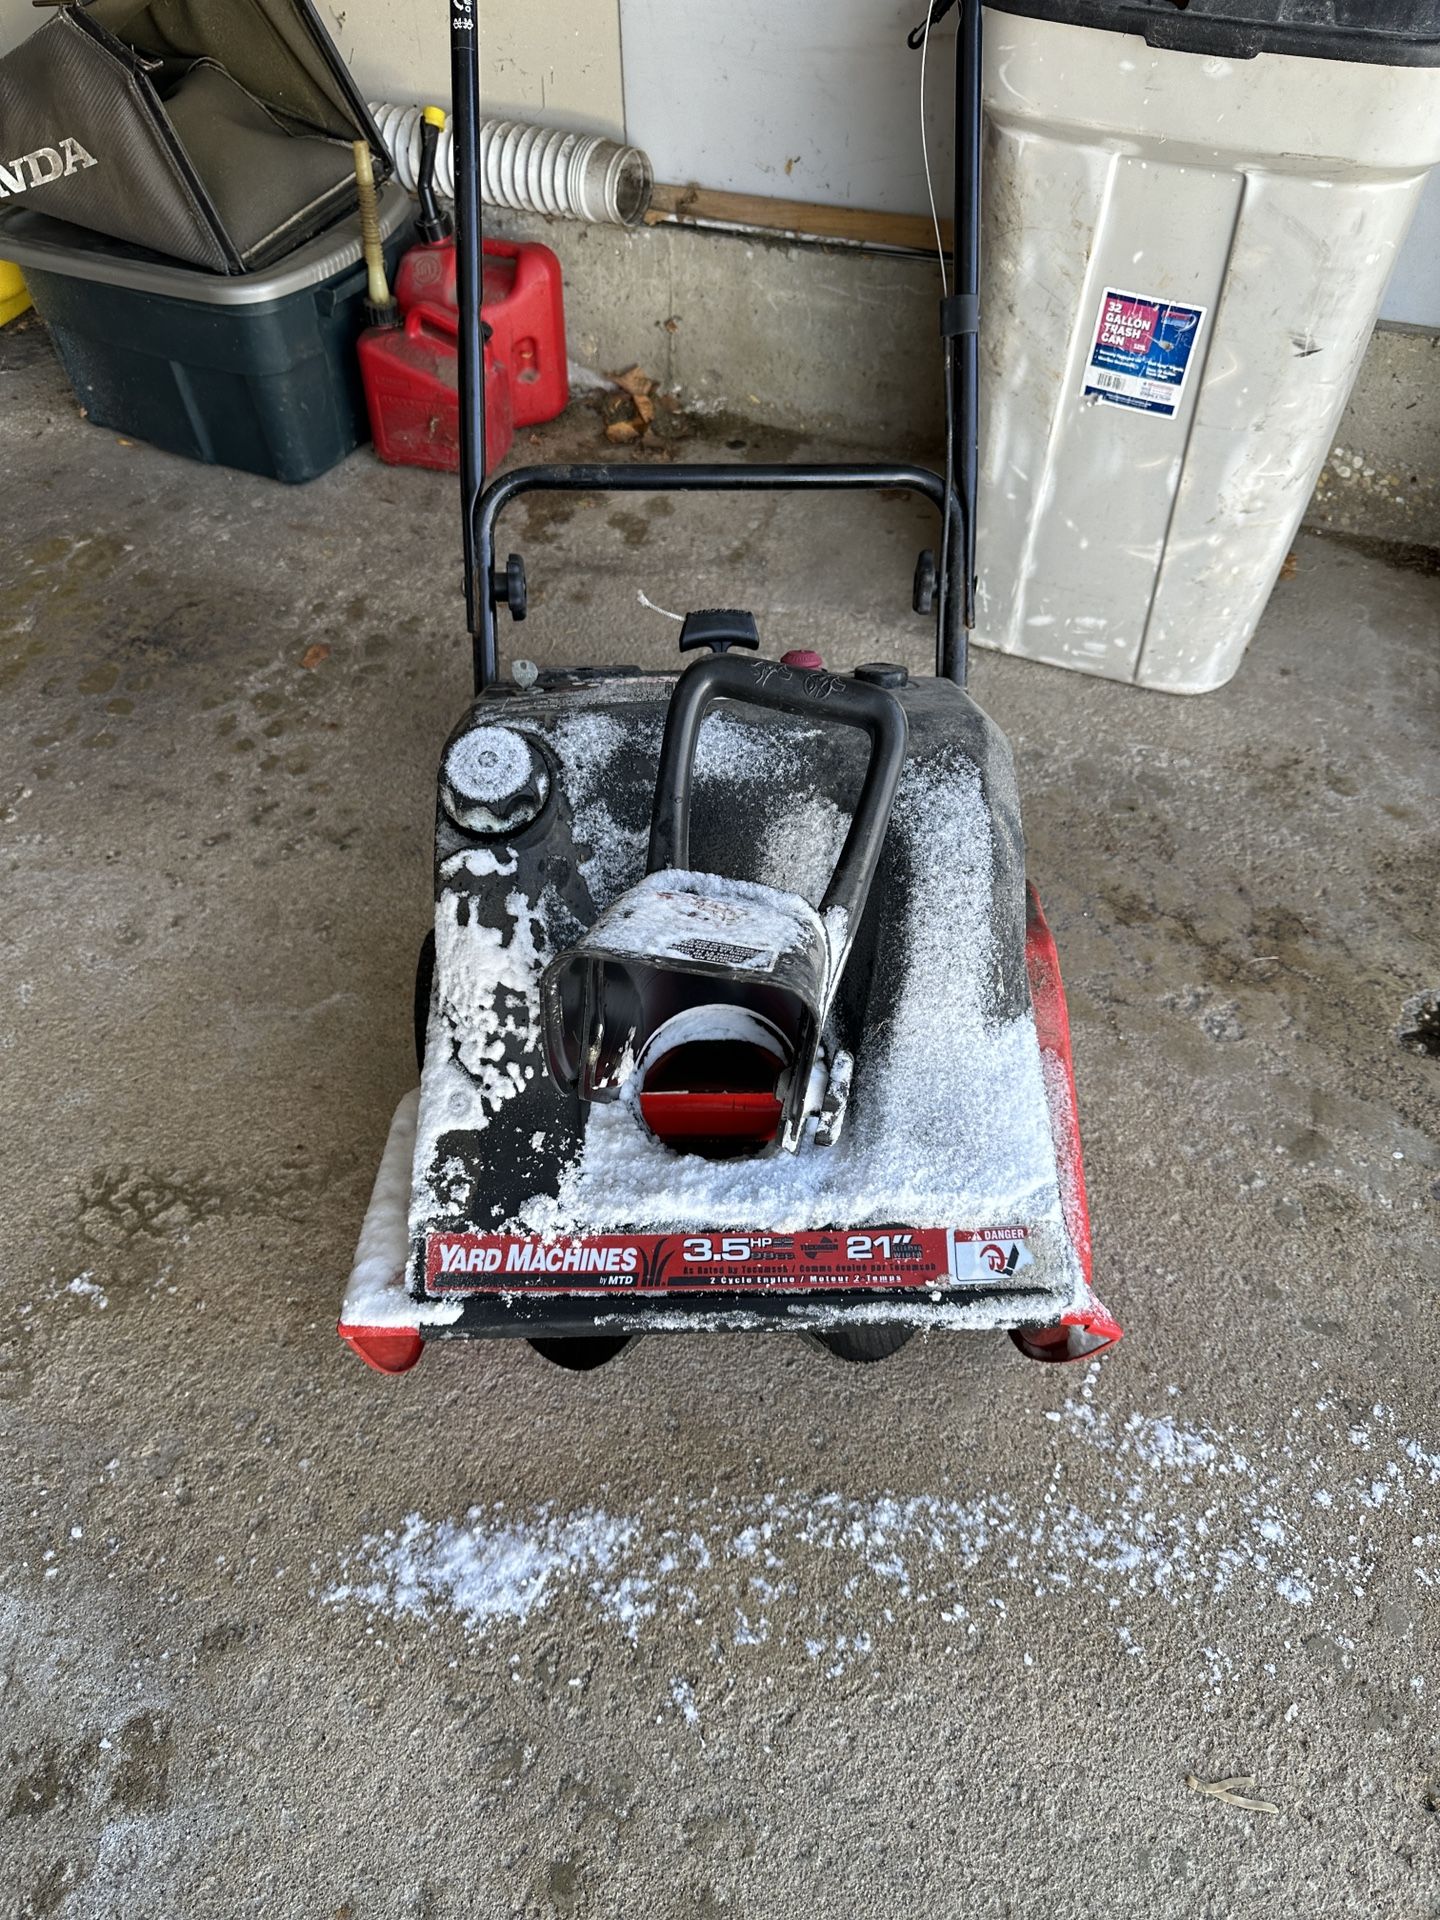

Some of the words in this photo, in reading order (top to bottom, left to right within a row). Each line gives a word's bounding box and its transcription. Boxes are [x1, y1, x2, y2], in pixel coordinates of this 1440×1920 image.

[1108, 301, 1122, 313] 32
[1106, 312, 1151, 330] GALLON
[1104, 322, 1142, 339] TRASH
[1101, 332, 1125, 346] CAN
[984, 1229, 1024, 1240] DANGER
[683, 1238, 751, 1261] 3.5
[751, 1237, 772, 1247] HP
[439, 1244, 502, 1272] YARD
[506, 1244, 638, 1272] MACHINES
[683, 1266, 693, 1274] As
[728, 1266, 739, 1274] by
[600, 1276, 607, 1285] by
[608, 1275, 634, 1285] MTD
[721, 1276, 752, 1284] Cycle
[757, 1275, 795, 1284] Engine
[810, 1275, 849, 1283] Moteur
